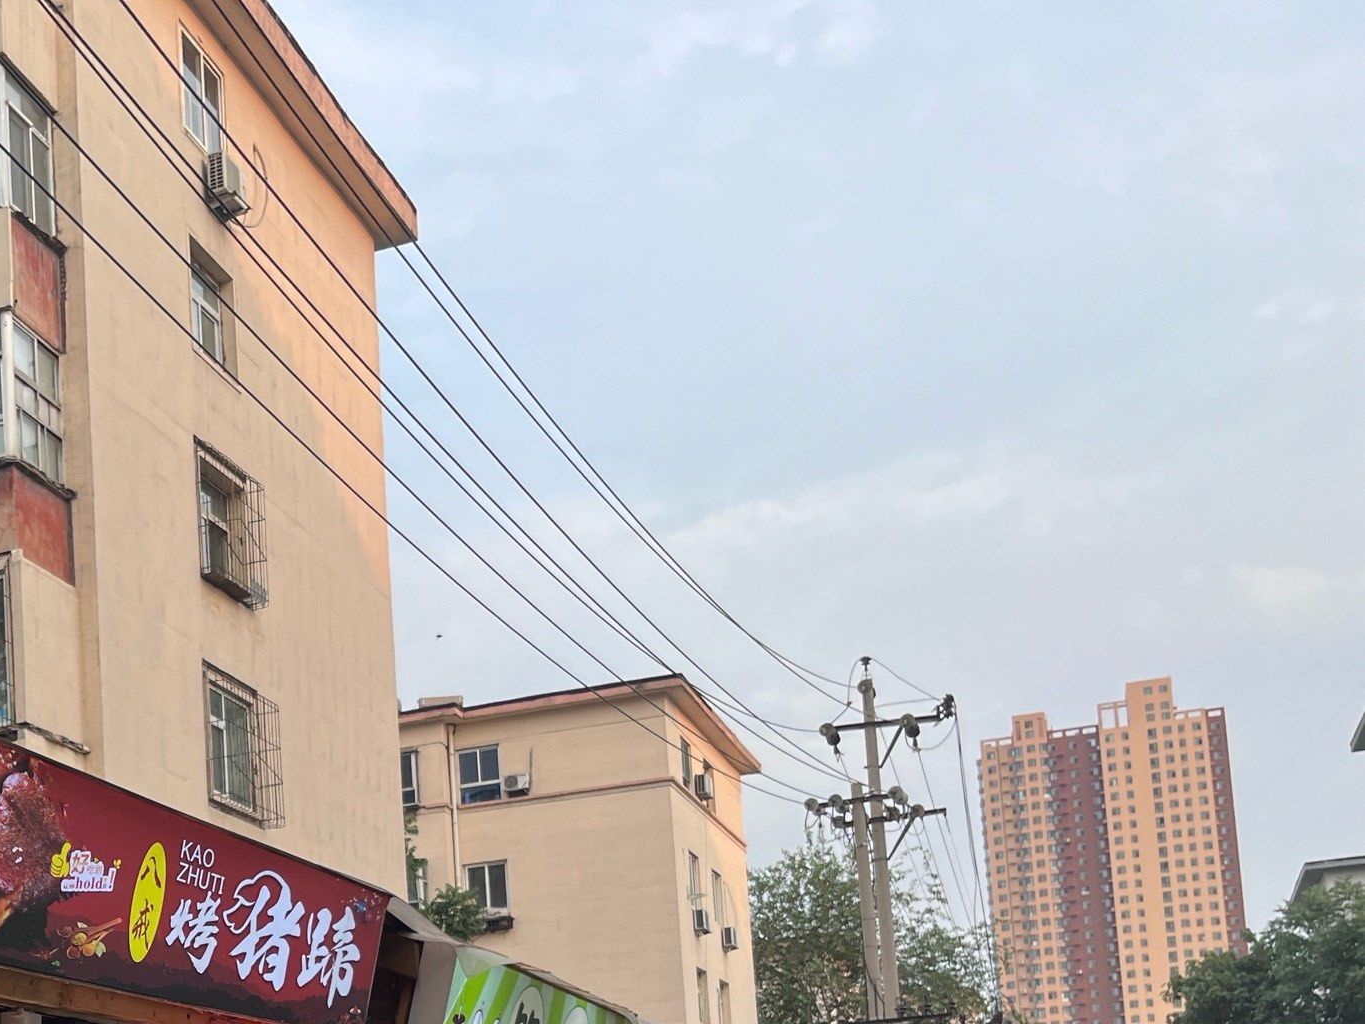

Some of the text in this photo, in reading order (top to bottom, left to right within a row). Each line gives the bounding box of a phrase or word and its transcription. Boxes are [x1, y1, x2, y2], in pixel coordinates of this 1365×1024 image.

[176, 862, 225, 895] ZHUTI
[181, 839, 215, 868] KAO
[132, 856, 162, 949] 八戒
[166, 884, 361, 1009] 烤猪蹄
